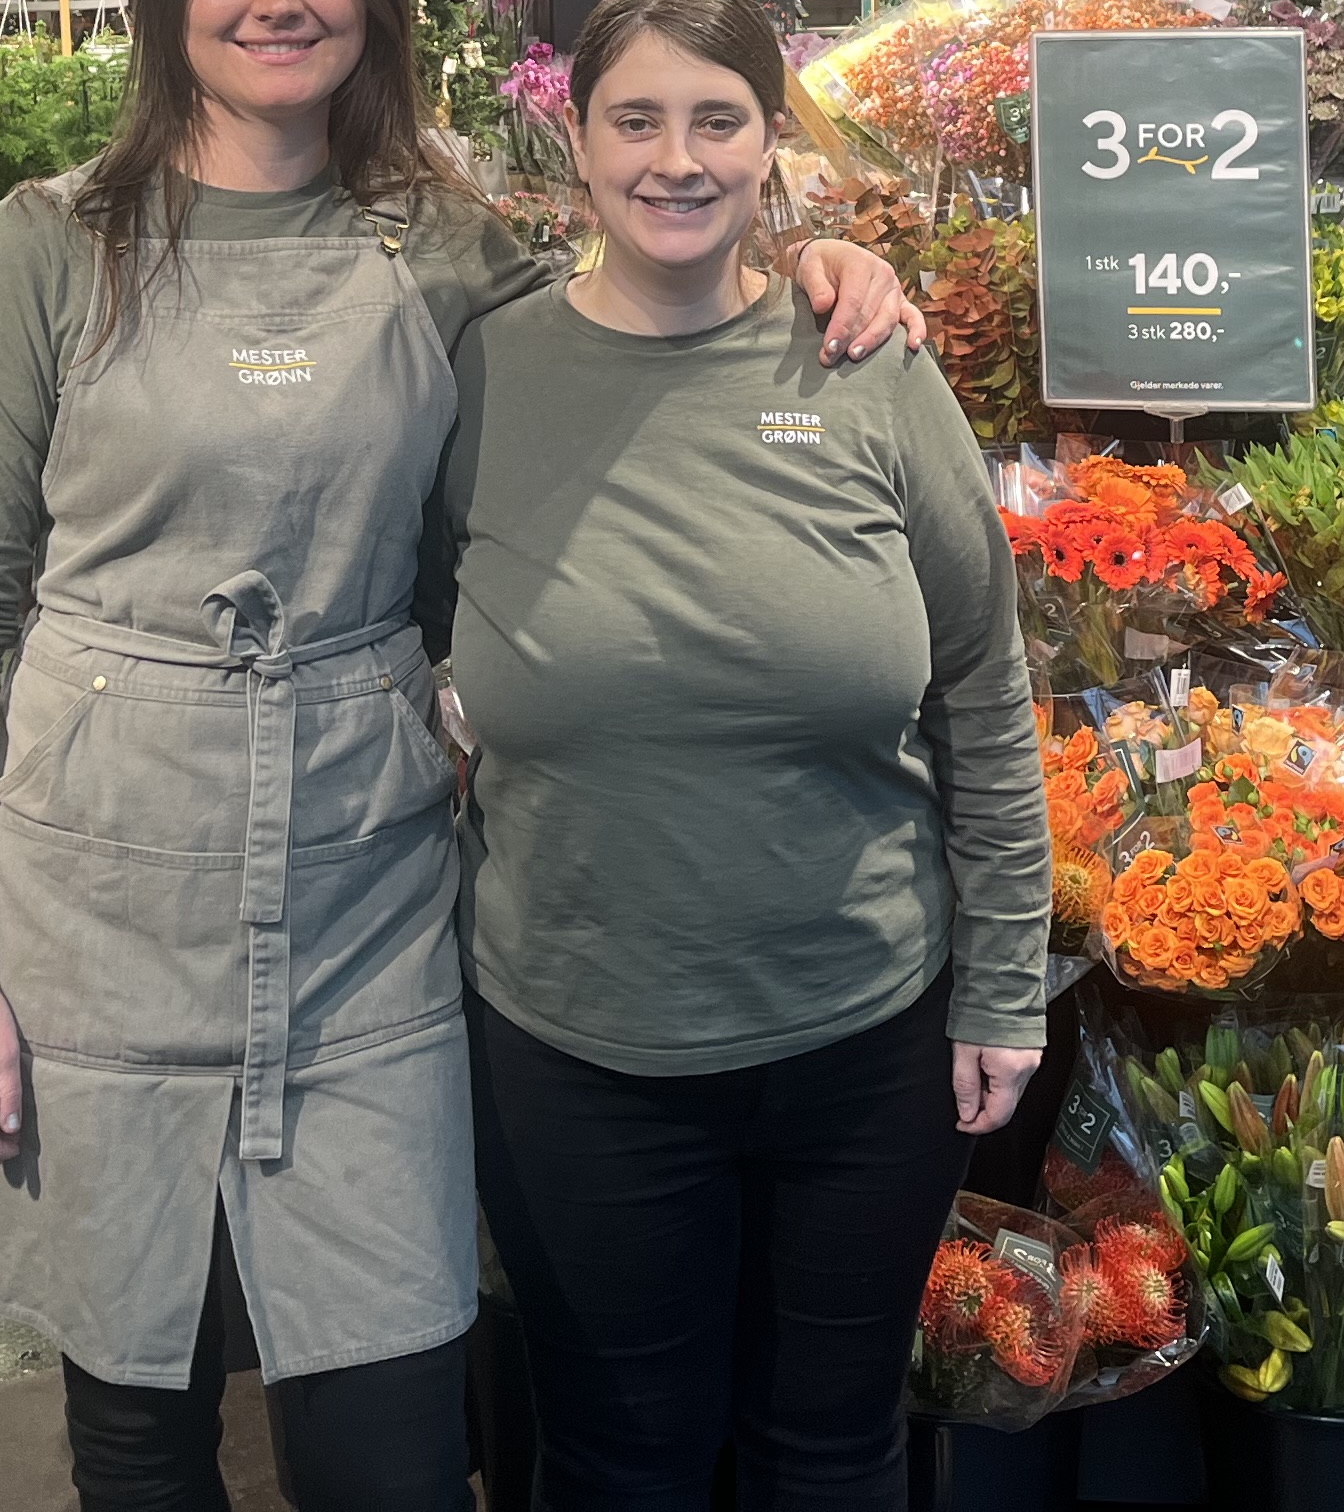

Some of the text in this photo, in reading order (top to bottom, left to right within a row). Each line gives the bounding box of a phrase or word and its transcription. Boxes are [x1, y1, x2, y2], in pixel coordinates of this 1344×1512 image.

[1081, 109, 1260, 180] 3 FOR 2
[1127, 252, 1241, 296] 140,-
[1128, 321, 1225, 342] 3 stk 280,-
[232, 348, 309, 365] MESTER
[238, 367, 312, 385] GRØNN
[1130, 380, 1224, 391] Gjelder merkede varer.
[760, 412, 821, 427] MESTER
[761, 430, 821, 444] GRØNN
[1140, 831, 1155, 849] 2
[1068, 1095, 1081, 1114] 3
[1080, 1113, 1096, 1135] 2
